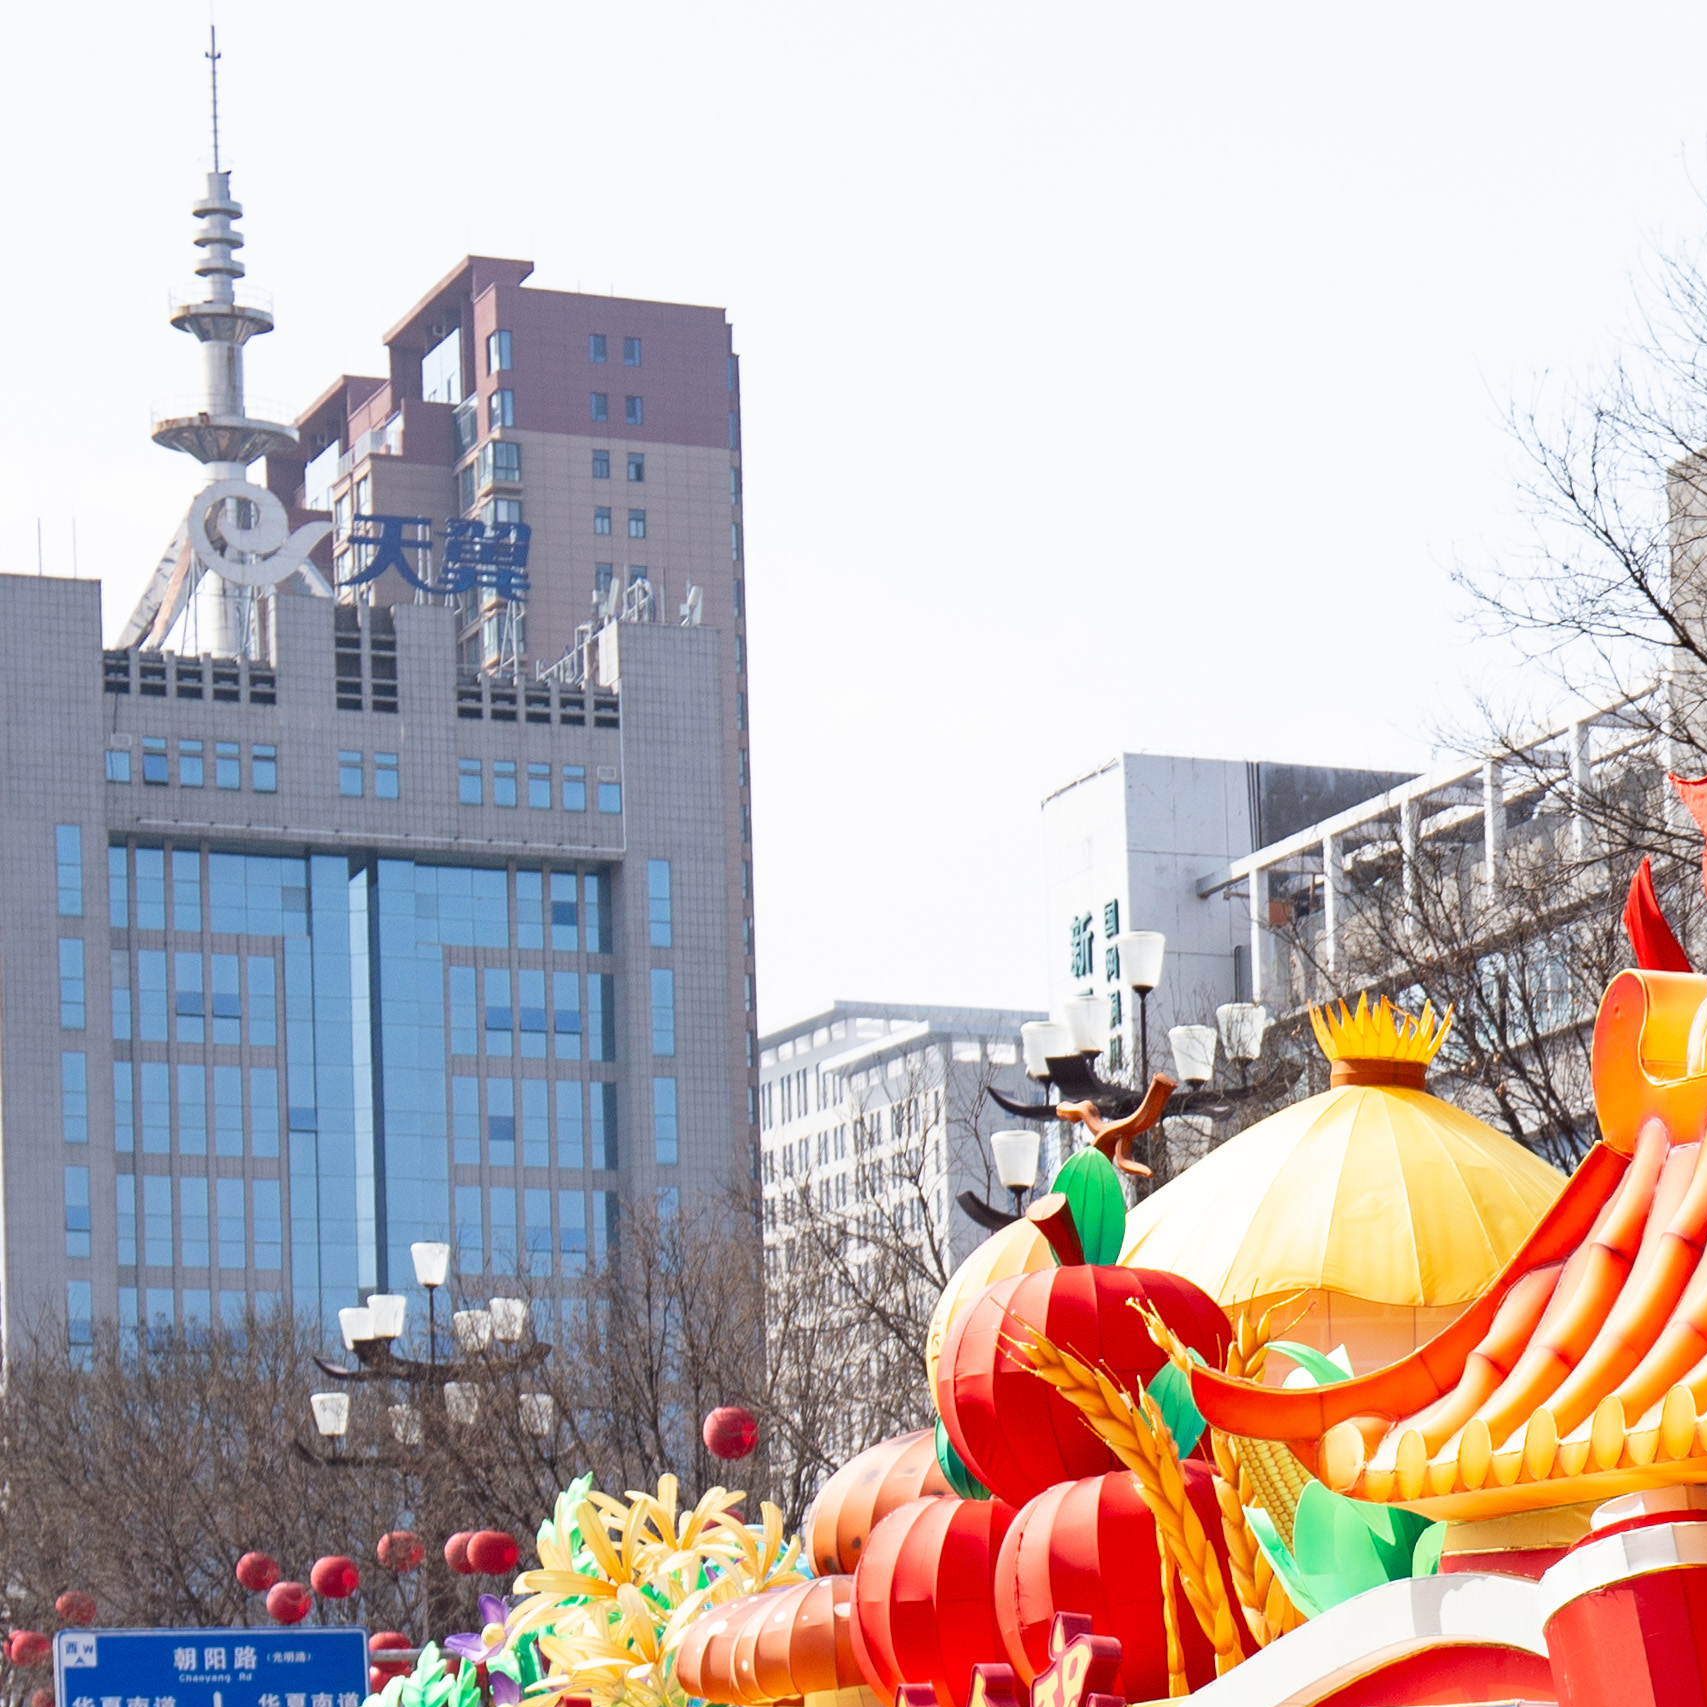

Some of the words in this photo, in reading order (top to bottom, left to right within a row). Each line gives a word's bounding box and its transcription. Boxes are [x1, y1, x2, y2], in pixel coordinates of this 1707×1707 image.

[334, 513, 532, 602] 天翼
[1070, 911, 1095, 997] 新
[82, 1644, 94, 1655] W
[173, 1645, 258, 1671] 朝阳路
[179, 1673, 232, 1684] Chaoyang
[238, 1672, 253, 1682] Rd
